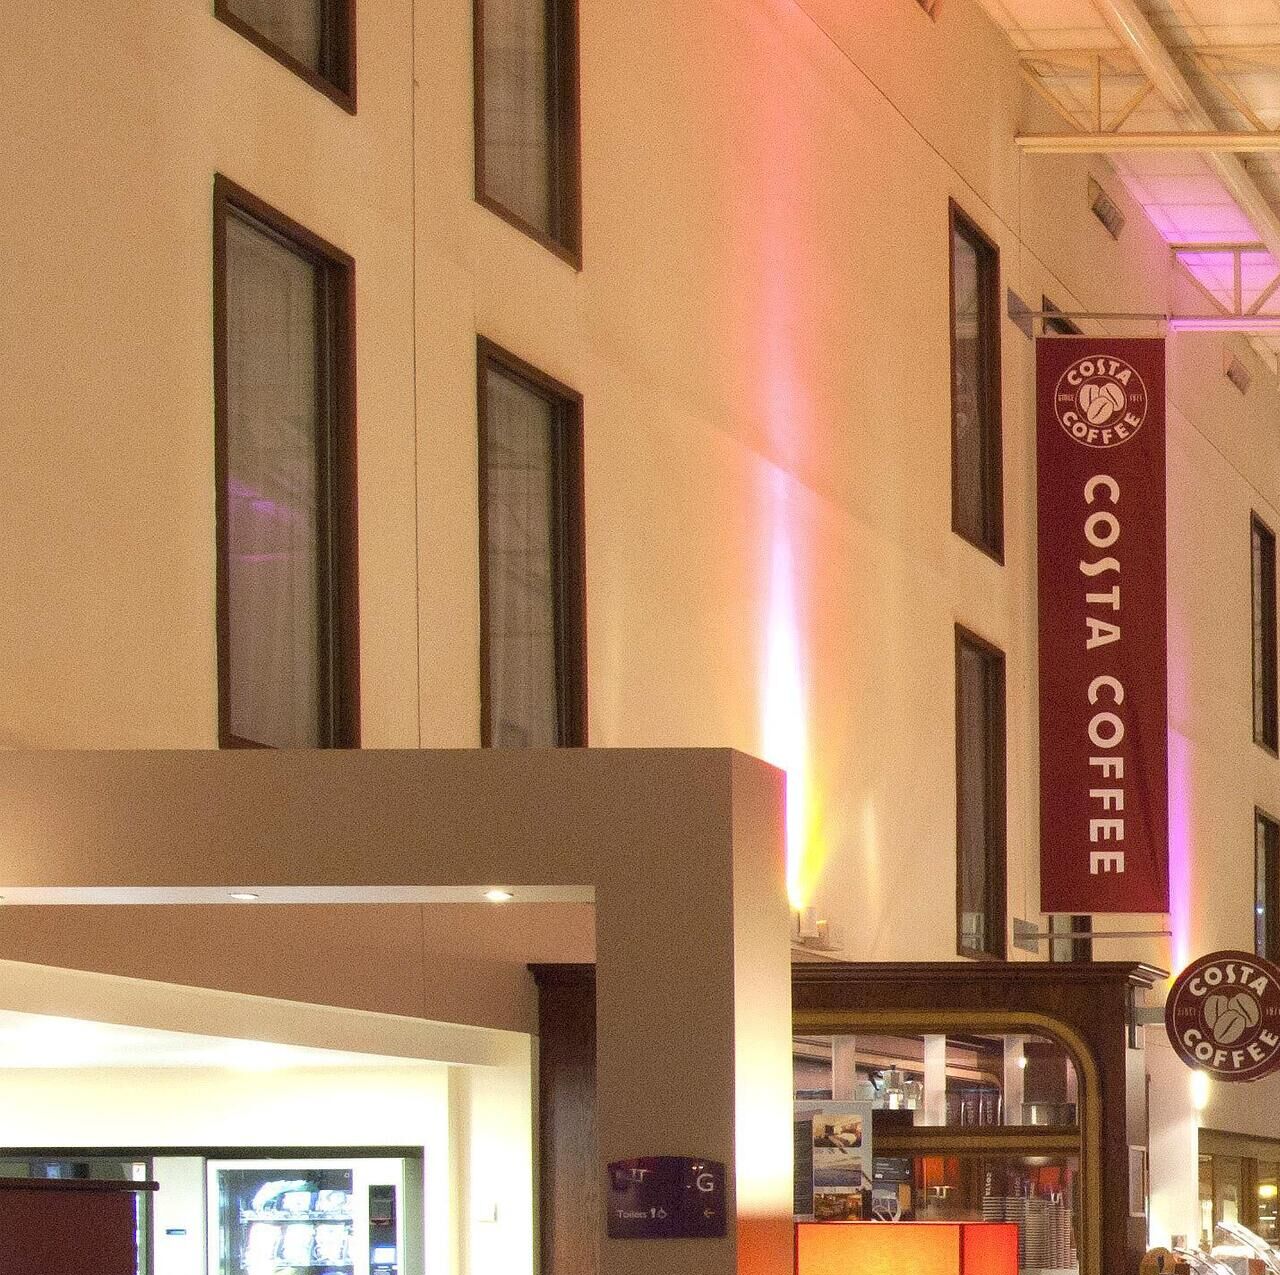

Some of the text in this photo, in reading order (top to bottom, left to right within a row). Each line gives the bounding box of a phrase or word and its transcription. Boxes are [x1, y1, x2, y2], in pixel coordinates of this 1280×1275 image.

[1067, 359, 1132, 386] COSTA
[1062, 411, 1141, 445] COFFEE
[1079, 474, 1125, 875] COSTA COFFEE
[1189, 964, 1269, 997] COSTA
[1183, 1028, 1280, 1068] COFFEE
